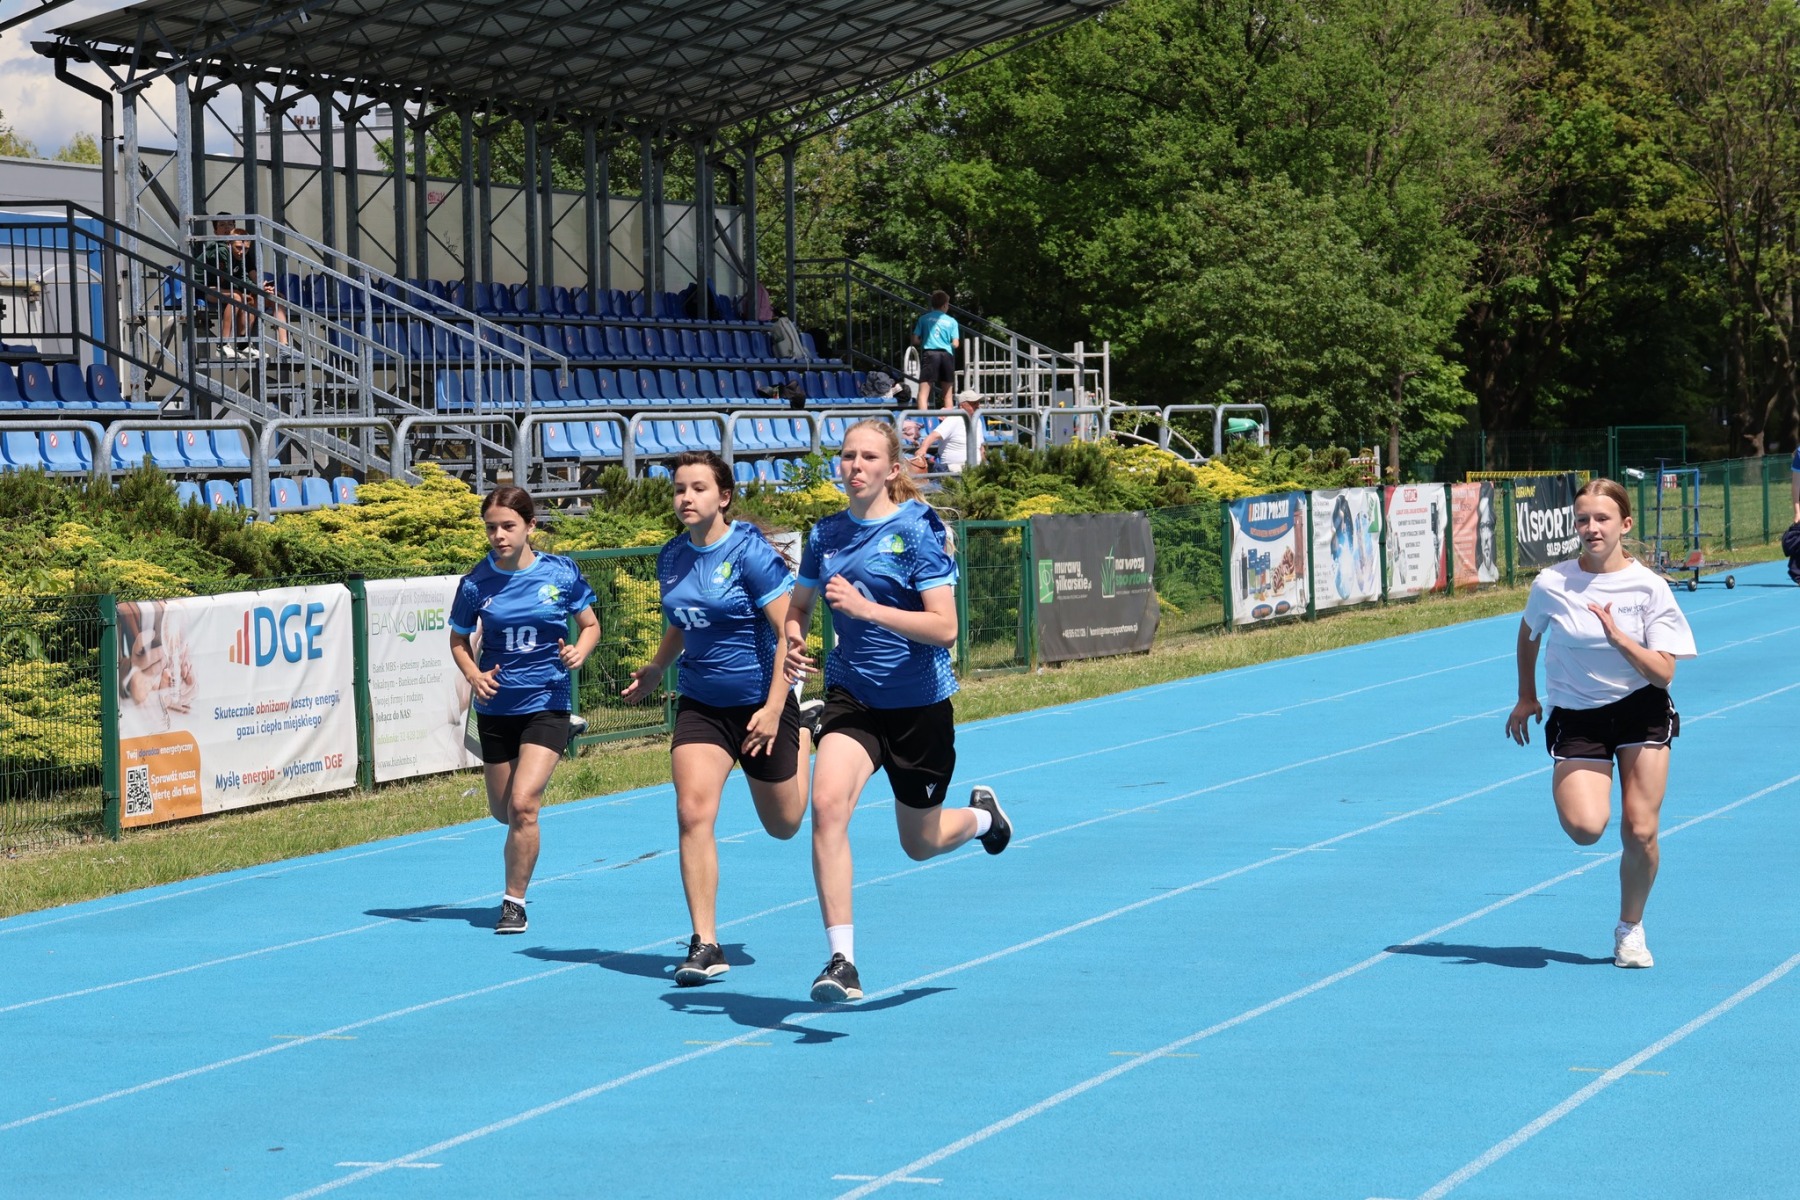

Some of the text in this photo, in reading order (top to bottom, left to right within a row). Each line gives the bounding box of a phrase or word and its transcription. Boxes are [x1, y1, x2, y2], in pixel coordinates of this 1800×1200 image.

[1268, 499, 1290, 520] POLSKA
[1546, 542, 1561, 557] SKLEP
[1054, 561, 1081, 577] murawy
[1115, 556, 1145, 573] nawozy
[673, 607, 711, 631] 16
[1617, 606, 1632, 614] NEW
[253, 602, 325, 667] DGE
[502, 625, 538, 652] 10
[373, 663, 385, 673] Bank
[385, 661, 397, 672] MBS
[214, 703, 255, 720] Skutecznie
[256, 699, 290, 715] obniżamy
[290, 696, 313, 710] koszty
[393, 710, 399, 720] do
[236, 725, 255, 740] gazu
[260, 719, 282, 735] ciepła
[283, 714, 322, 732] miejskiego
[160, 743, 193, 755] energetyczny
[151, 768, 196, 787] Sprawdź naszą
[215, 771, 240, 791] Myślę
[242, 766, 275, 785] energia
[283, 760, 323, 780] wybieram
[324, 753, 343, 770] DGE
[172, 786, 182, 796] dla
